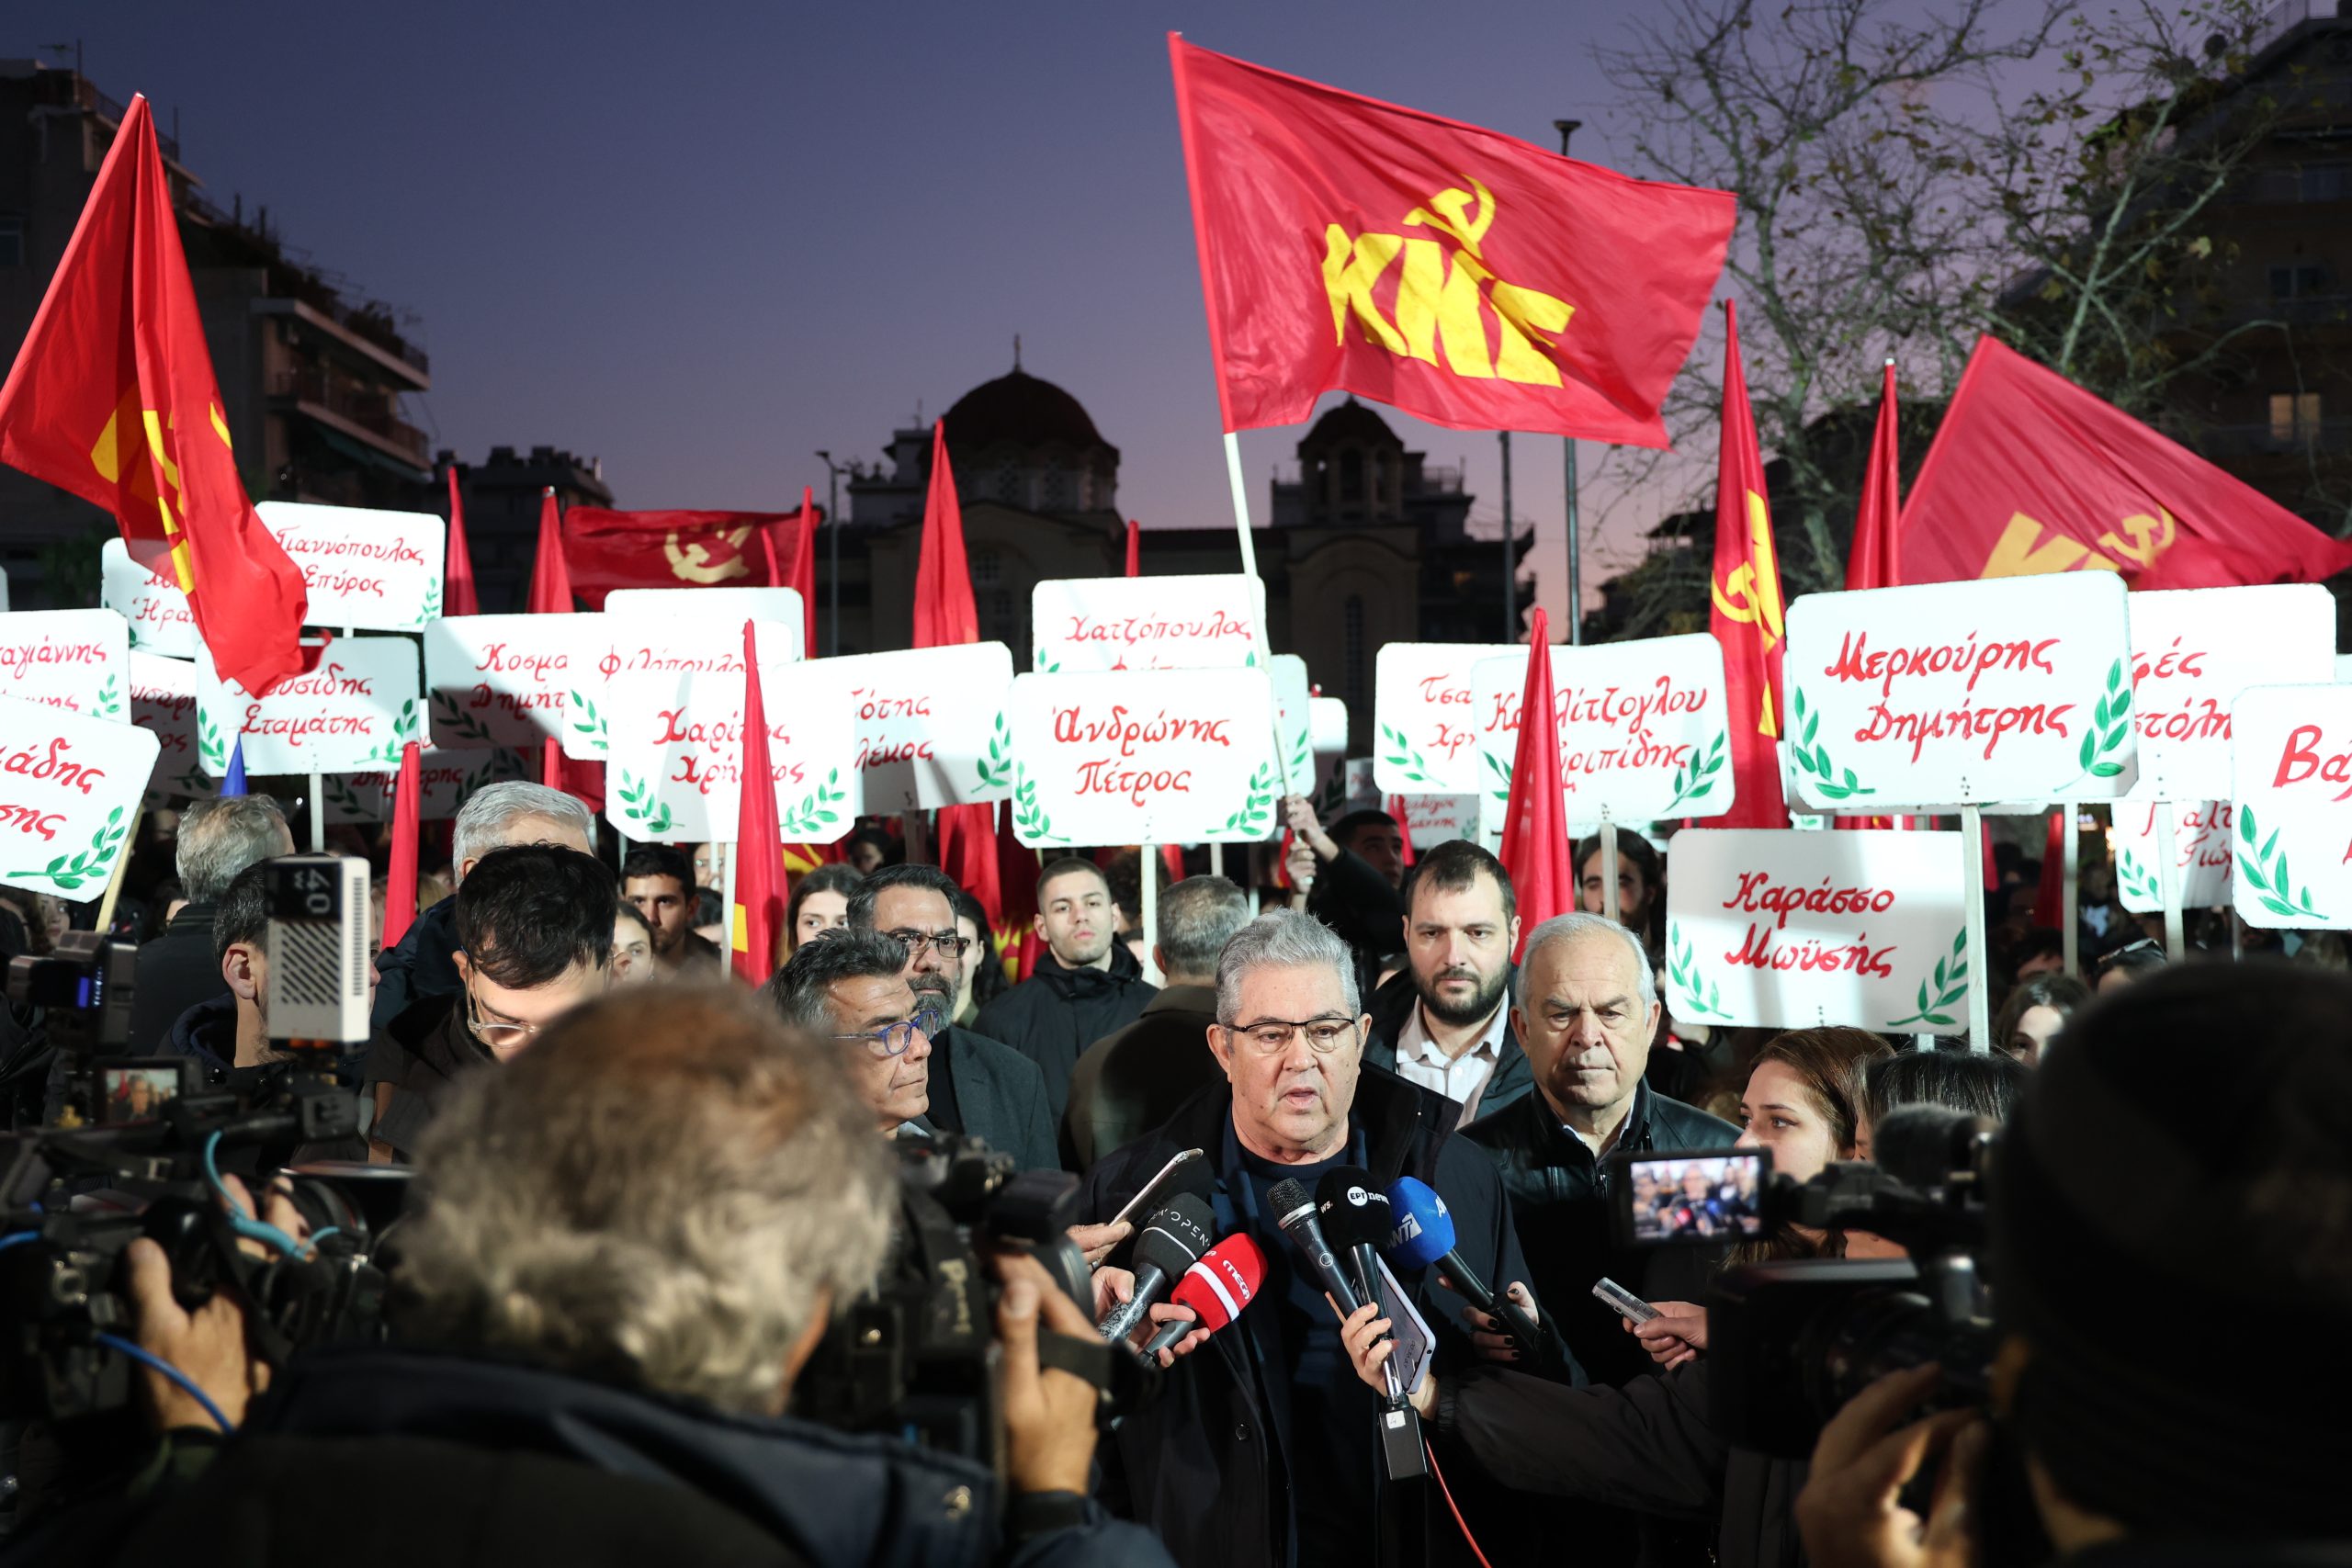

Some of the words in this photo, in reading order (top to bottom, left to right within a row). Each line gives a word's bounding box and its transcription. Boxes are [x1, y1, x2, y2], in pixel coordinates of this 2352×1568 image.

[304, 564, 386, 598] Σπύρος
[1063, 608, 1253, 648] Χατζόπουλος
[0, 634, 107, 680] αγιάννης
[598, 643, 747, 683] Φιλόπουλο
[1824, 630, 2061, 698] Μερκούρης
[469, 678, 565, 721] Δημήτ
[1484, 673, 1708, 735] Καλίτζογλου
[240, 702, 376, 748] Σταμάτης
[651, 705, 791, 754] Χαρίς
[1854, 697, 2076, 765] Δημήτρης
[0, 735, 107, 795] άδης
[670, 752, 806, 796] Χρήος
[1073, 757, 1193, 808] Πέτρος
[1560, 728, 1693, 794] ριπίδης
[1722, 870, 1896, 931] Καράσσο
[1170, 1211, 1210, 1247] OPEN
[1222, 1259, 1250, 1300] MEGA
